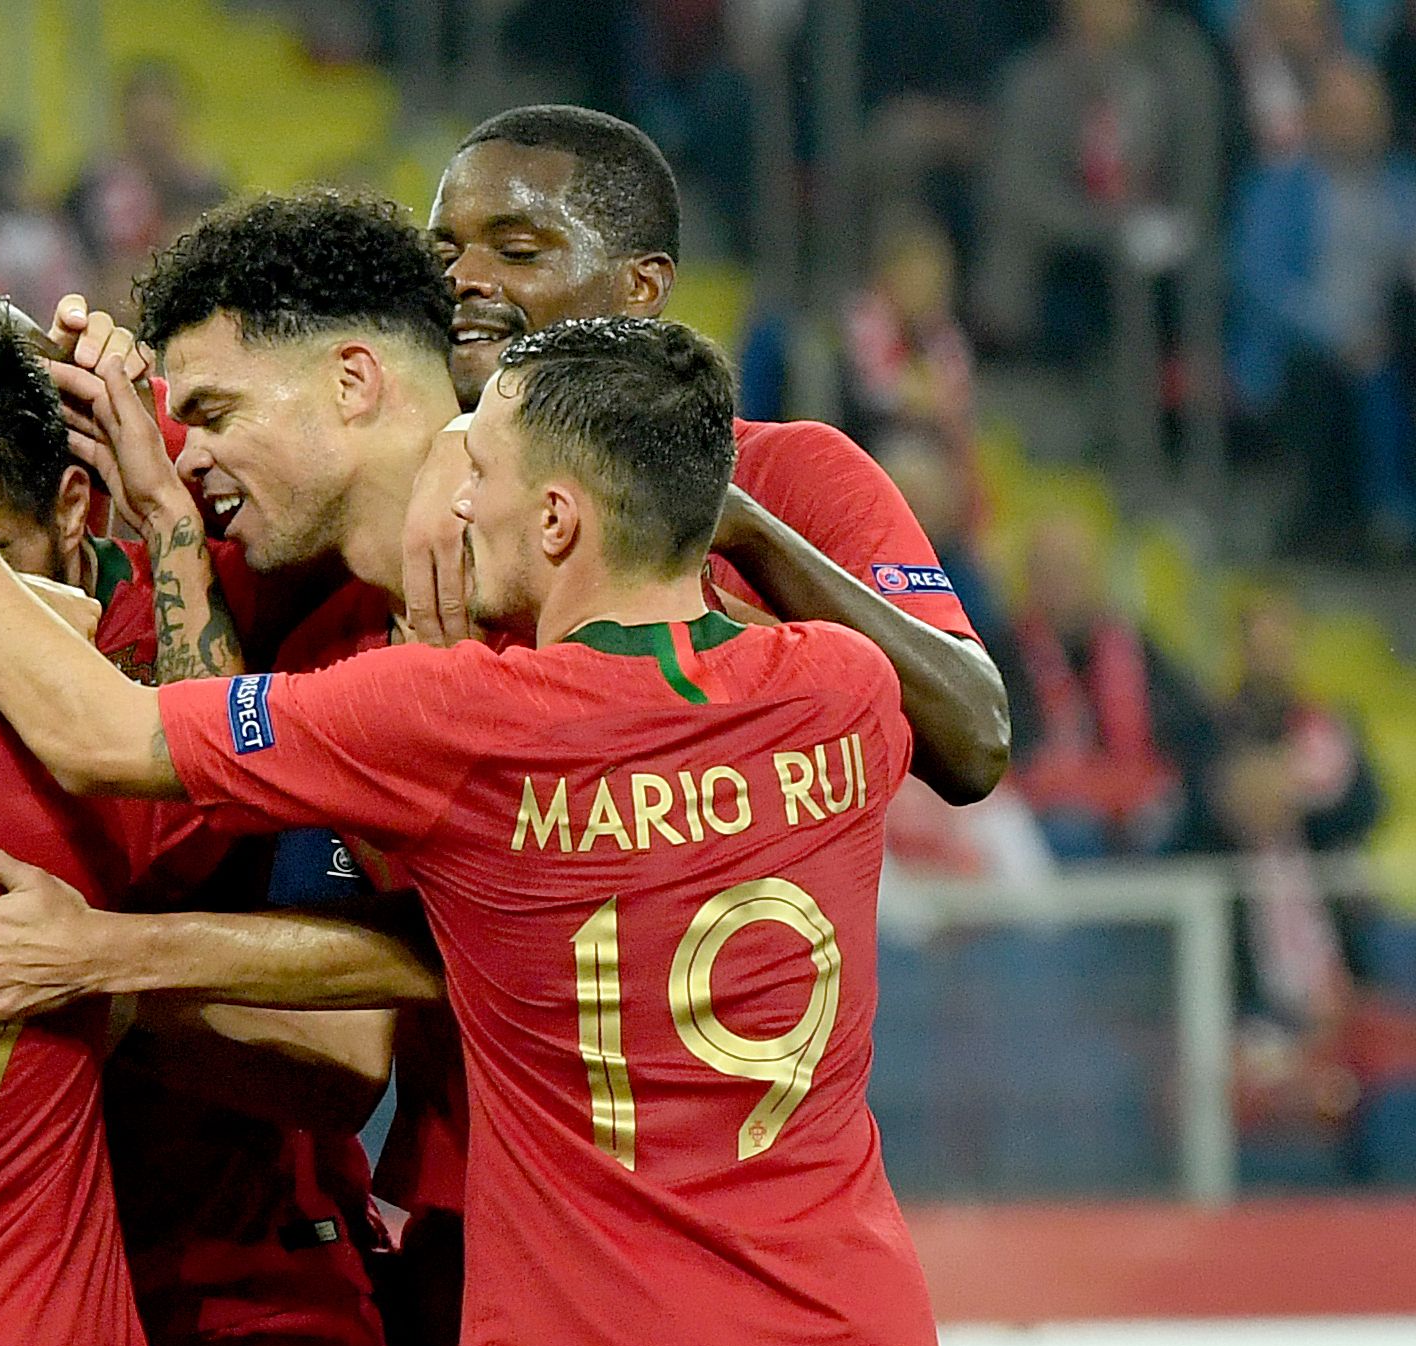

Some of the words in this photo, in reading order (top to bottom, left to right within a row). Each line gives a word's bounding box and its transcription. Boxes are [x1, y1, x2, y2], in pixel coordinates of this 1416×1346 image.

[236, 676, 264, 748] RESPECT
[510, 765, 753, 854] MARIO
[773, 733, 867, 826] RUI
[570, 877, 843, 1172] 19
